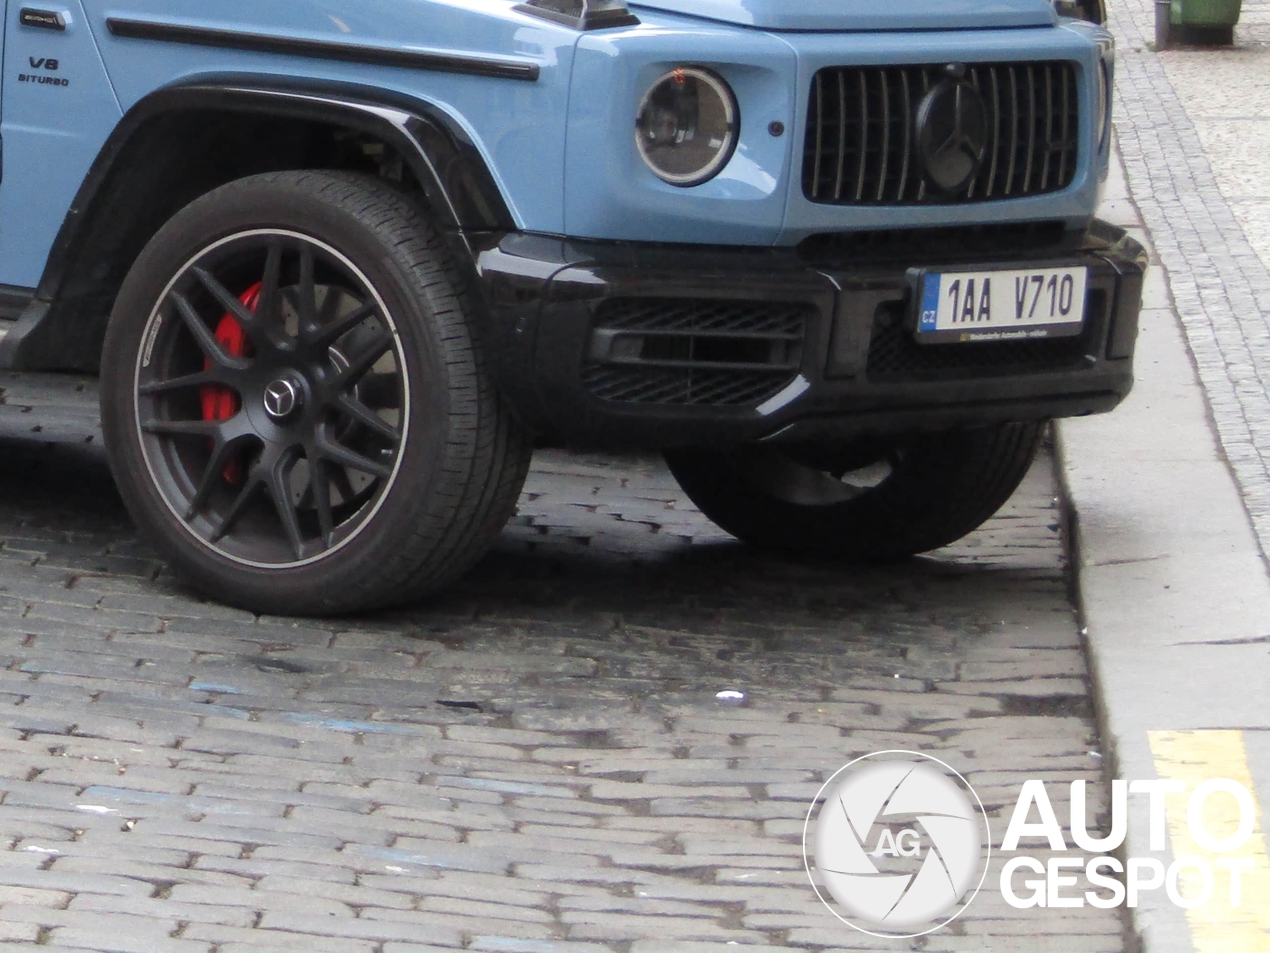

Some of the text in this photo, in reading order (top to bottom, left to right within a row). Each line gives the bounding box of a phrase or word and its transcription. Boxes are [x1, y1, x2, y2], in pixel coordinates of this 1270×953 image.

[29, 56, 59, 70] V8
[18, 73, 69, 87] BITURBO
[948, 274, 1074, 323] 1AA V710
[922, 310, 936, 323] CZ
